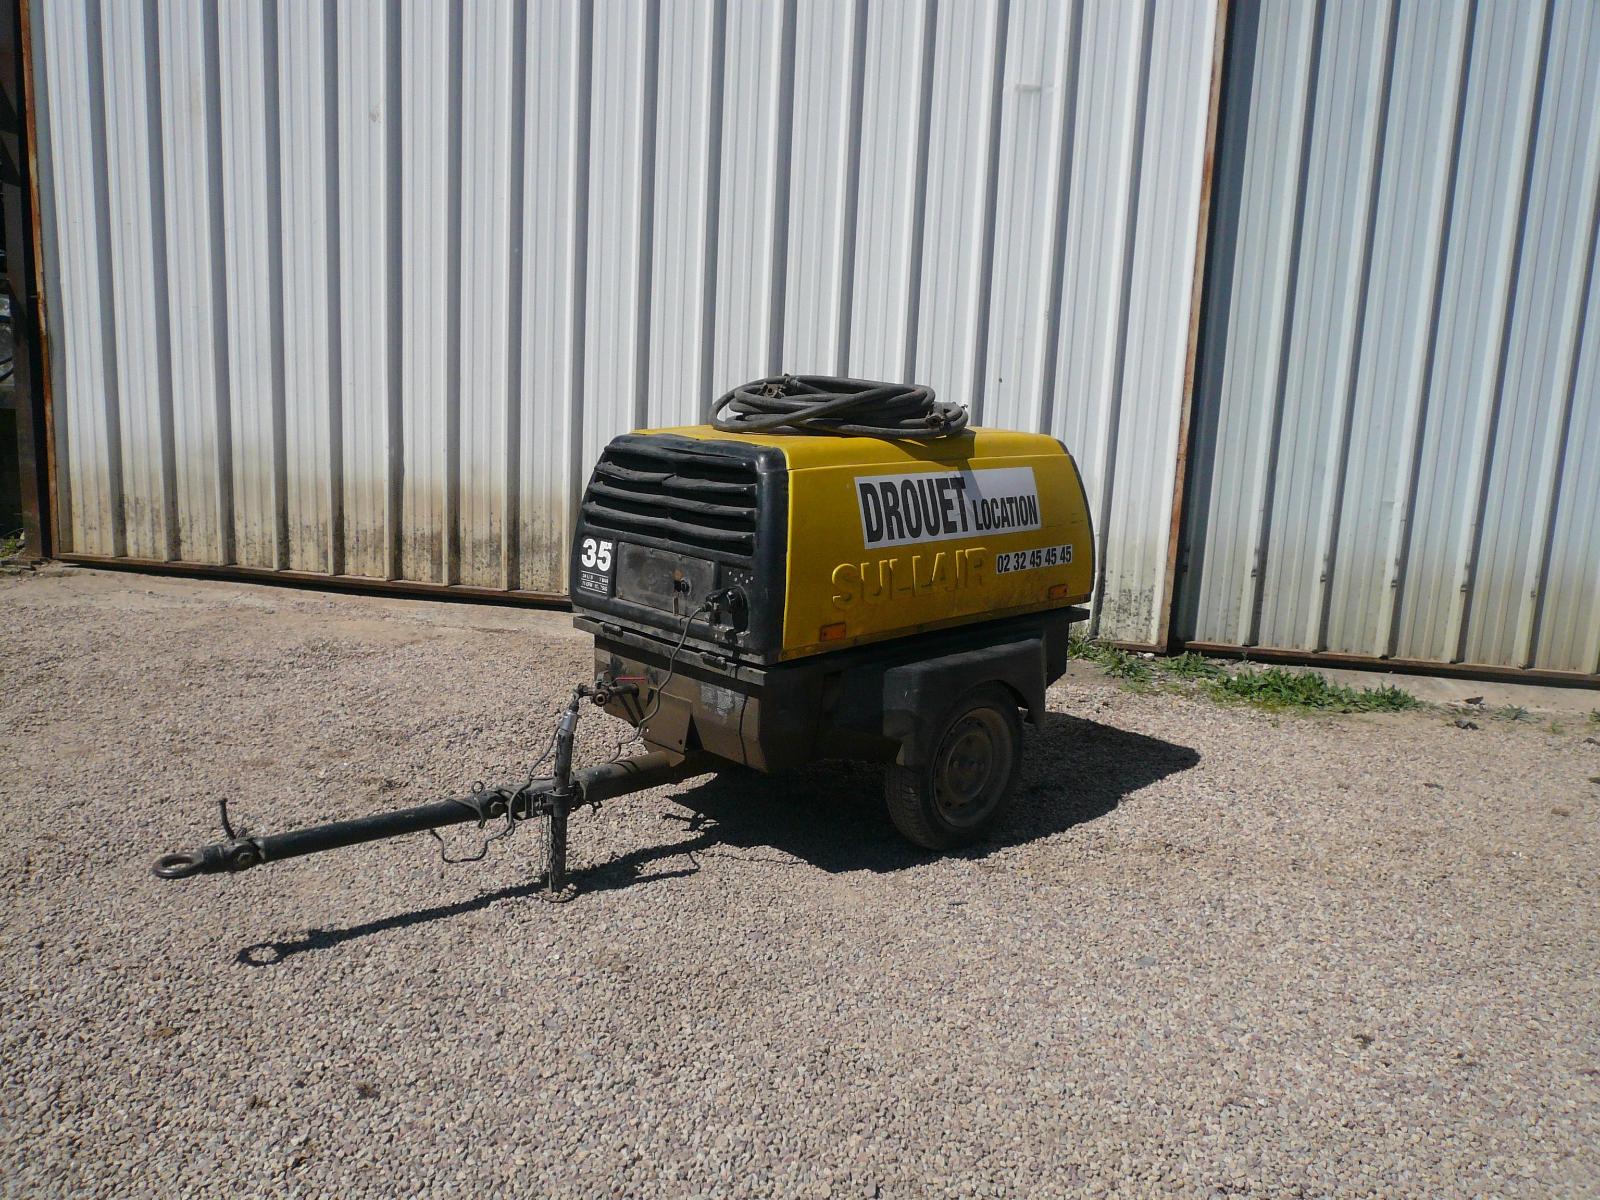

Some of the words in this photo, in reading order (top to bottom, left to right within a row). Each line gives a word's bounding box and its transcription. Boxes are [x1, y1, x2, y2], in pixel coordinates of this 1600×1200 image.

[859, 477, 969, 543] DROUET
[972, 494, 1039, 531] LOCATION
[581, 538, 613, 572] 35
[831, 547, 988, 612] SULLAIR
[997, 554, 1011, 573] 02
[1013, 552, 1027, 570] 32
[1030, 550, 1042, 567] 45
[1045, 547, 1057, 565] 45
[1060, 545, 1072, 563] 45
